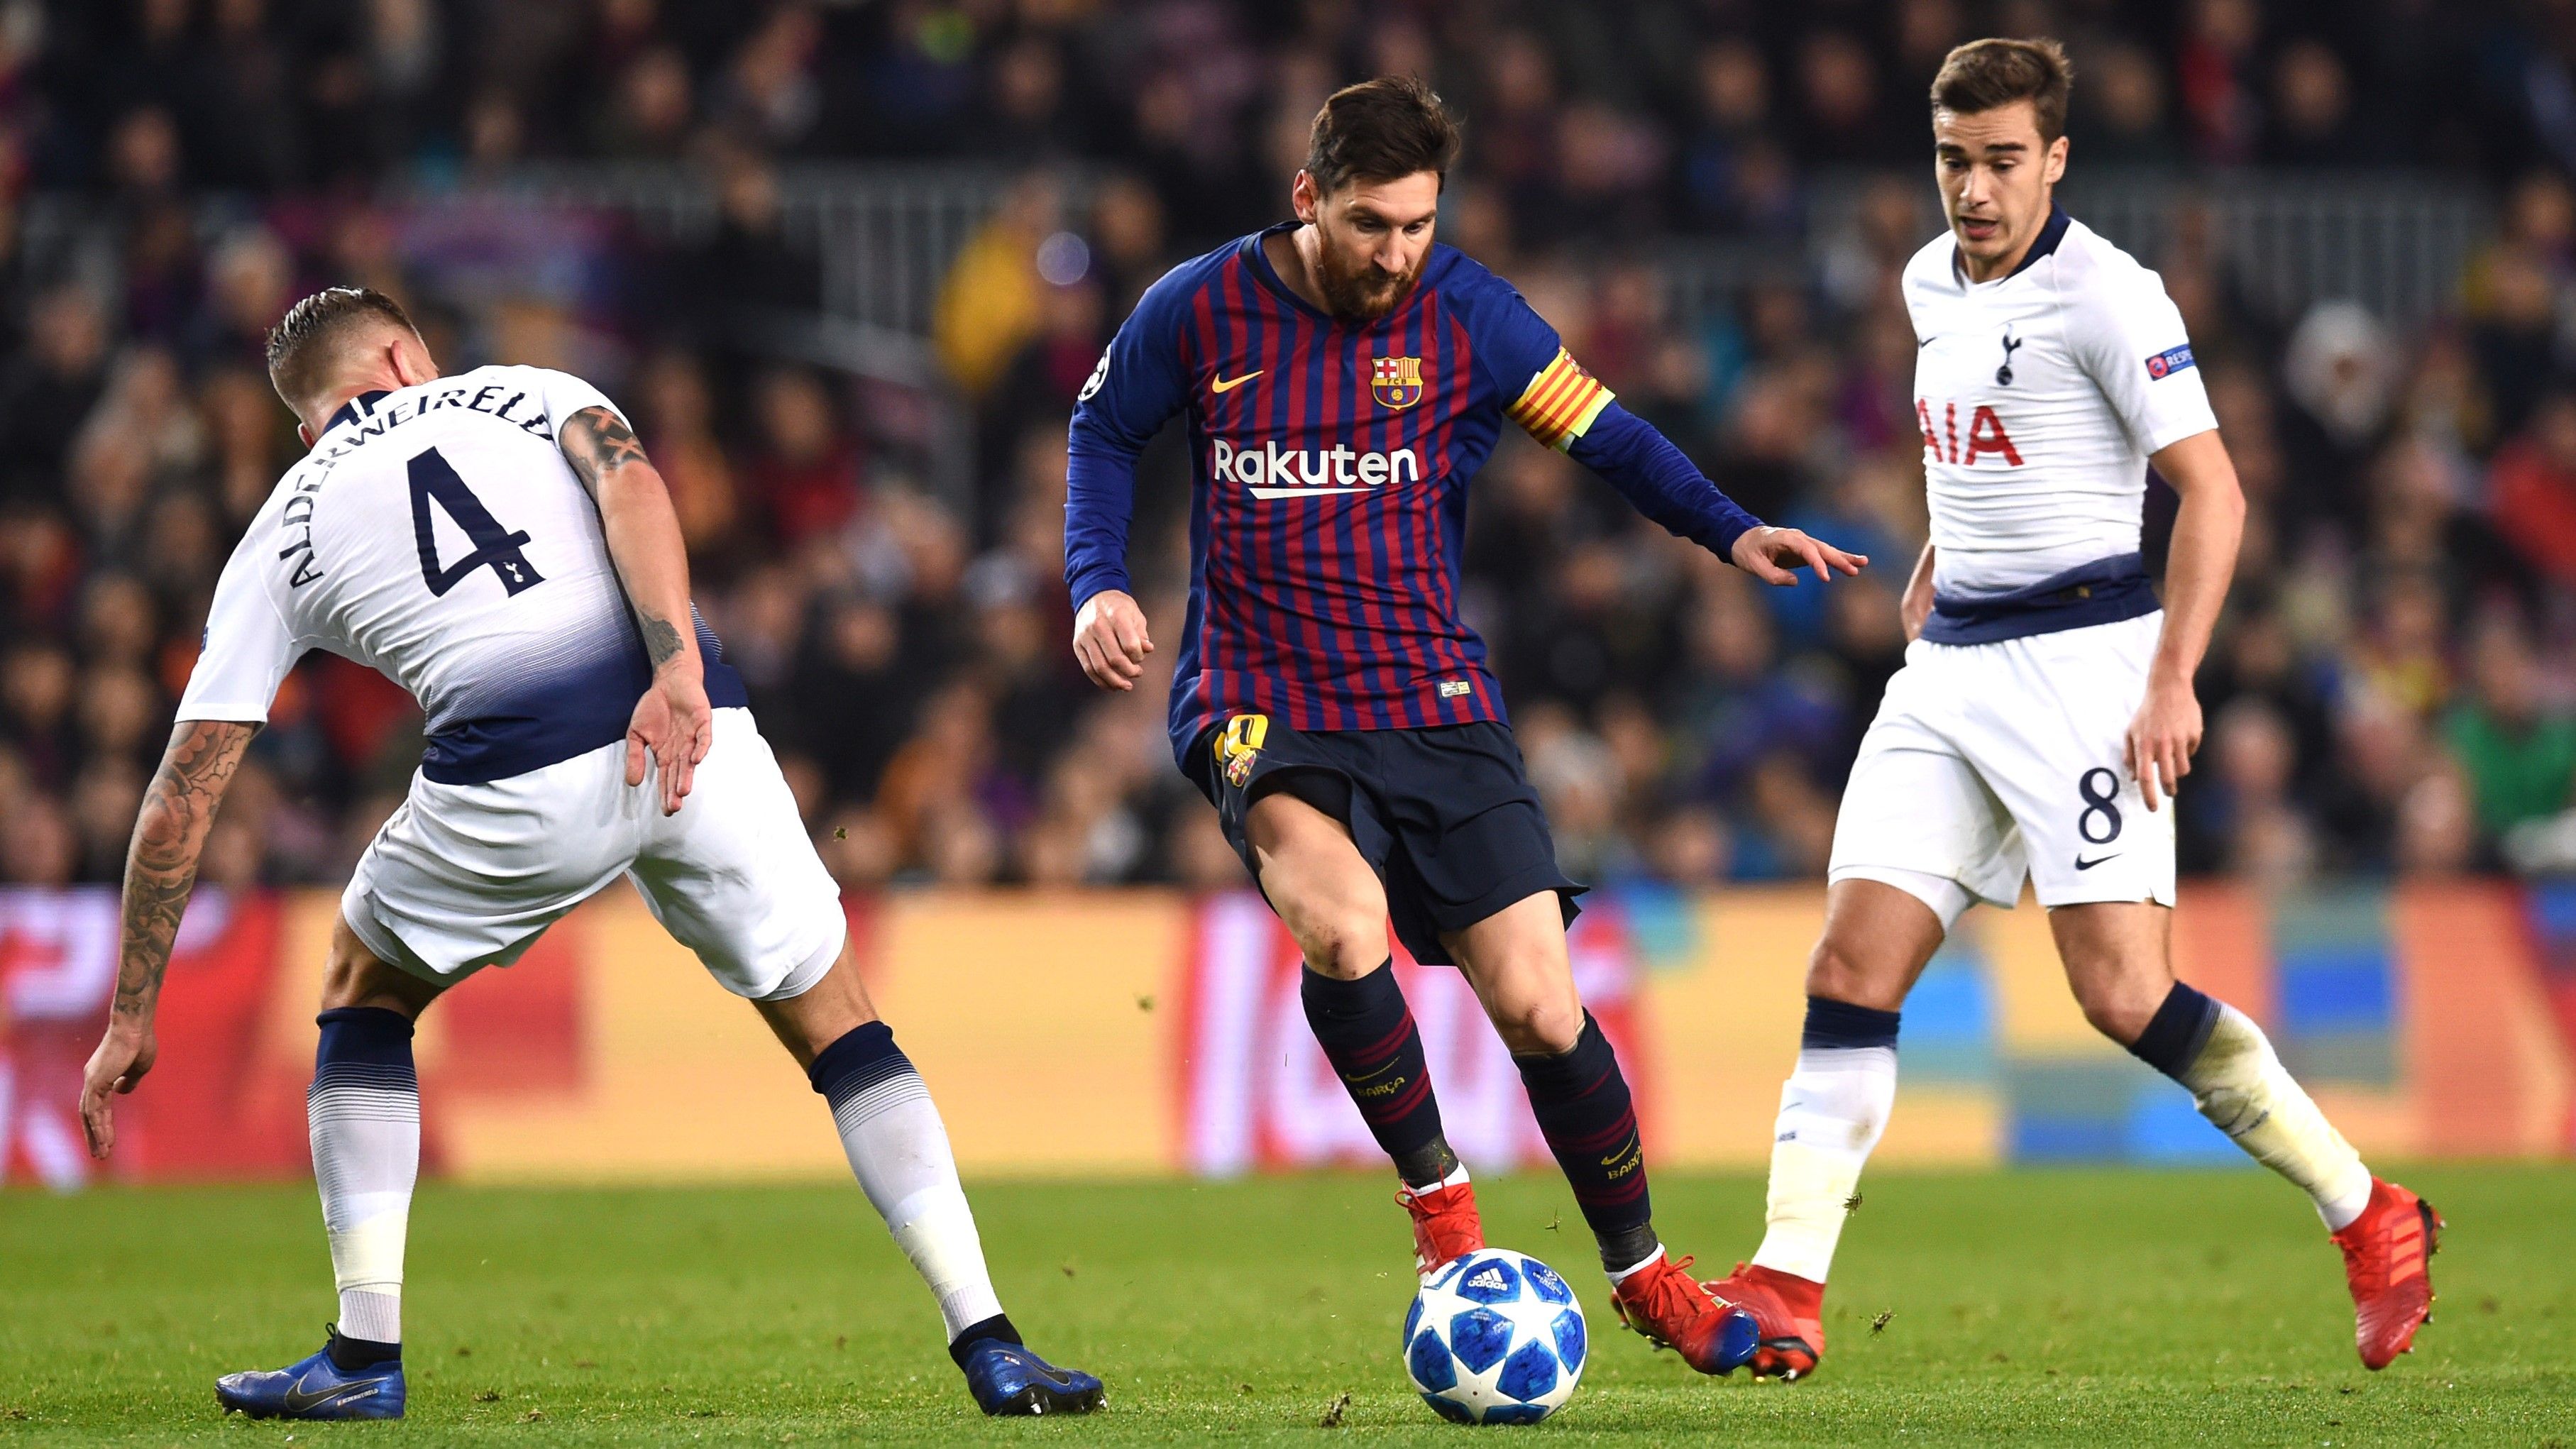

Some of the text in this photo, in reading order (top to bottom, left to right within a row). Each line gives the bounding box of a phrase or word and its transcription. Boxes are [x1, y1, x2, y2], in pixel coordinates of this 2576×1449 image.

[1213, 439, 1419, 485] Rakuten
[407, 446, 547, 598] 4
[2079, 767, 2123, 844] 8
[1355, 1076, 1405, 1097] BARÇA
[1467, 1279, 1509, 1291] adidas
